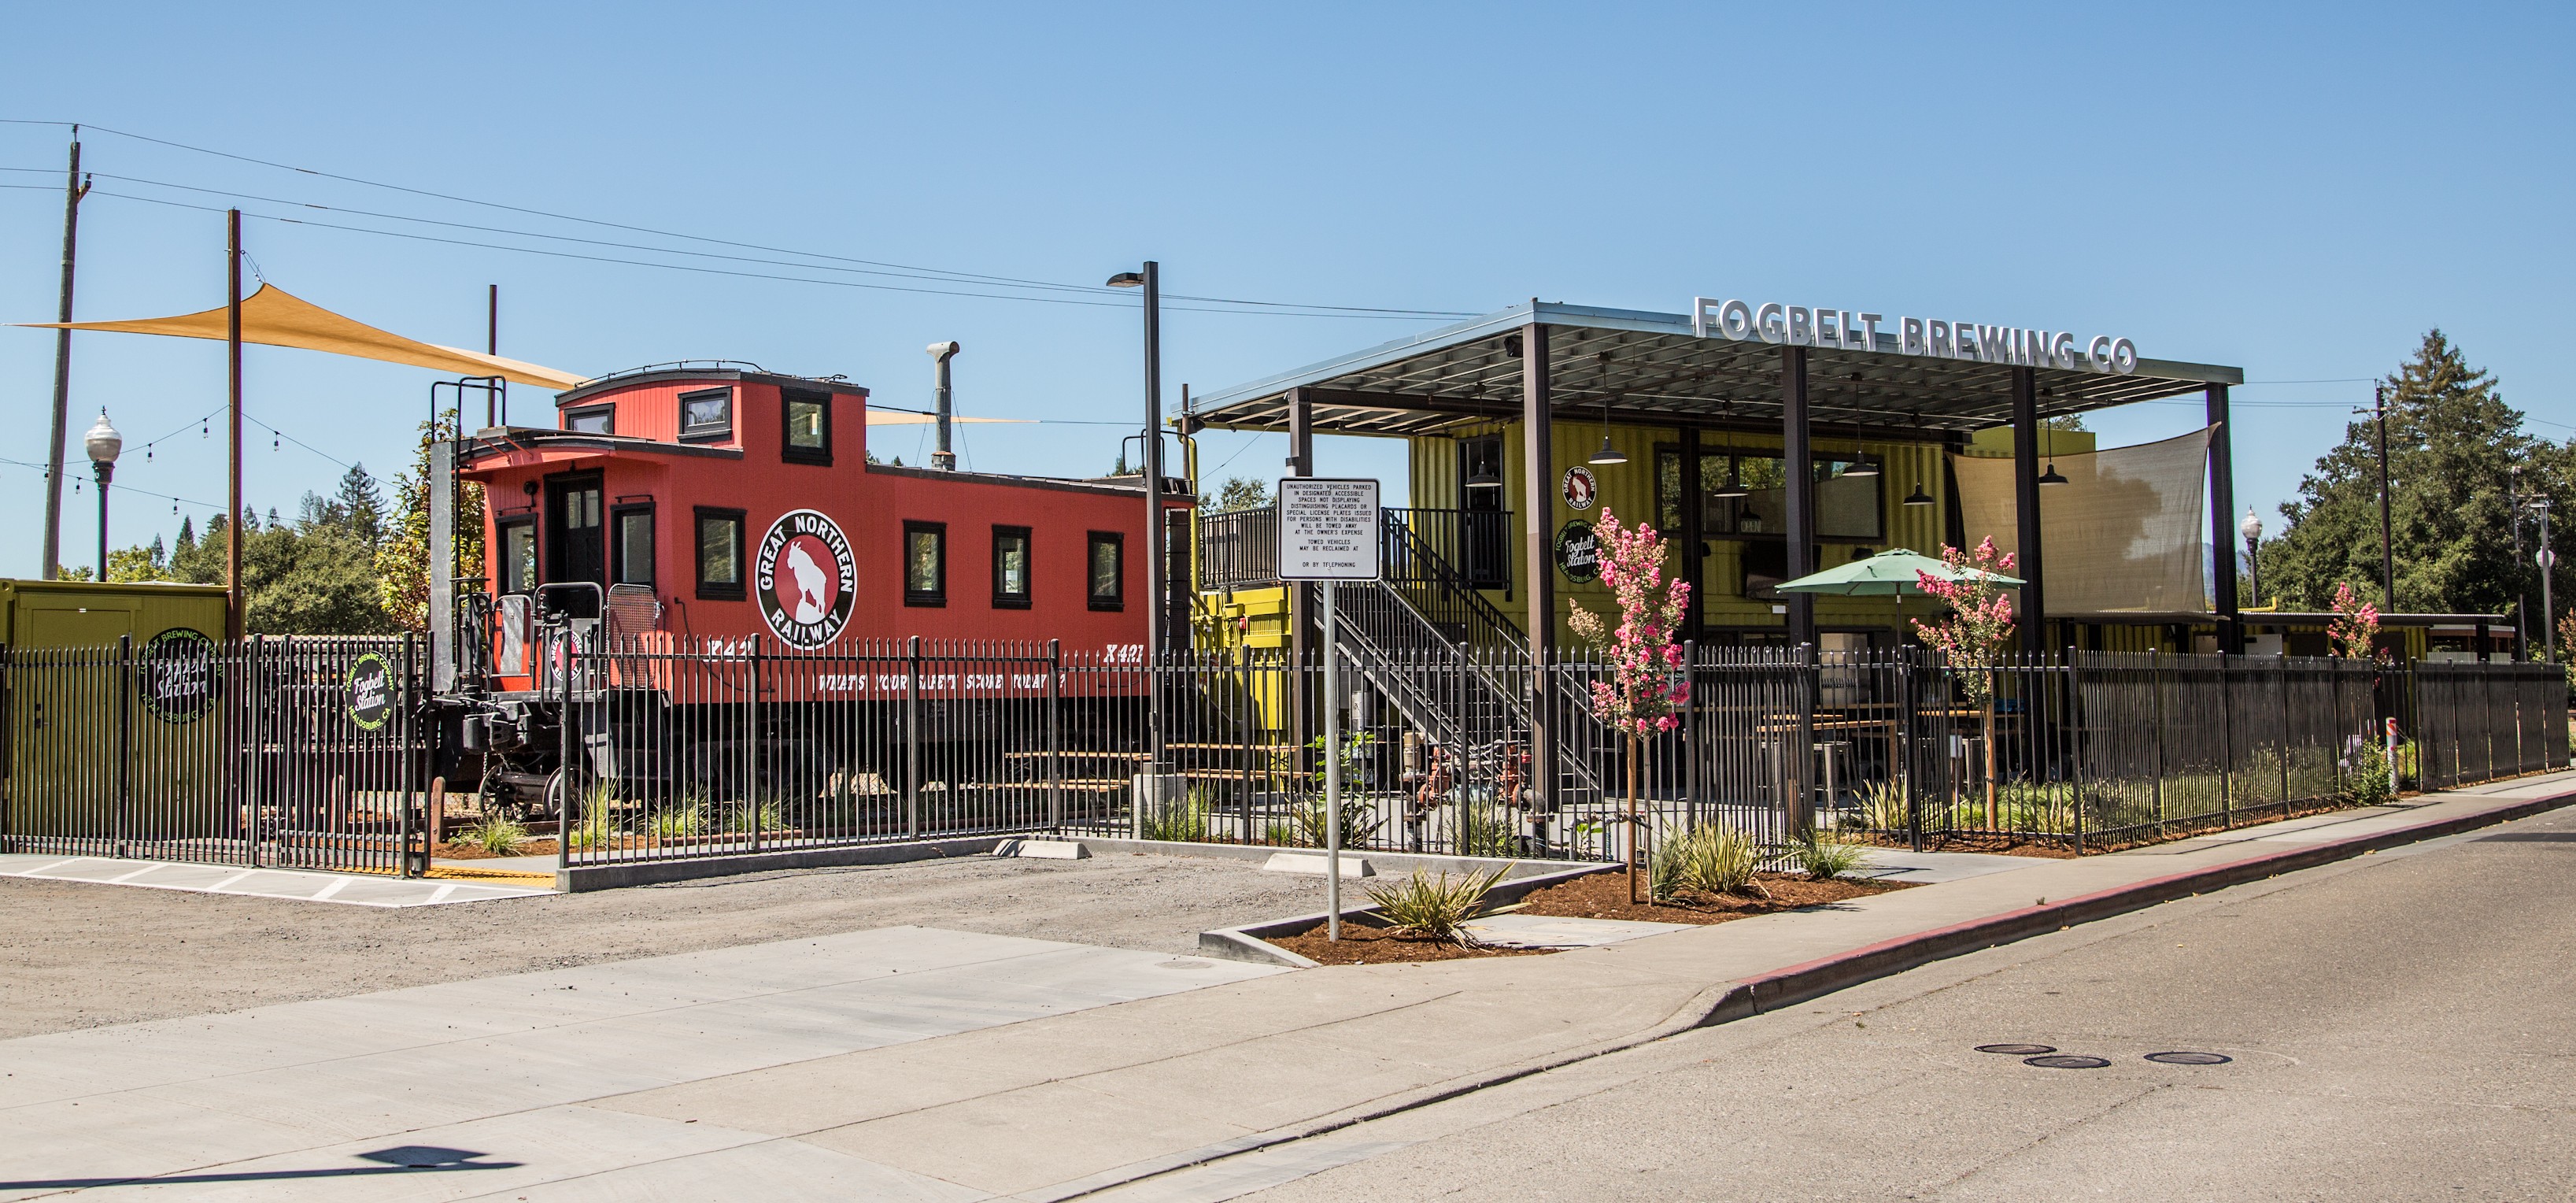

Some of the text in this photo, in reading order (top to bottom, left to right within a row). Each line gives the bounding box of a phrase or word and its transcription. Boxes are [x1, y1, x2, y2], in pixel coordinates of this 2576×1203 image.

[1695, 296, 2138, 375] FOGBELT BREWING CO
[1563, 468, 1595, 493] GREAT NORTHERN
[1568, 497, 1592, 508] RAILWAY
[1740, 520, 1761, 533] OPEN
[759, 515, 853, 593] GREAT NORTHERN
[1565, 535, 1595, 557] Fogbelt
[1566, 551, 1596, 567] Station
[161, 629, 198, 642] BREWING
[771, 608, 842, 644] RAILWAY
[346, 652, 394, 692] FOGBELT BREWING COMPANY
[353, 669, 385, 698] Fogbelt
[354, 690, 386, 712] Station
[382, 708, 391, 720] CA
